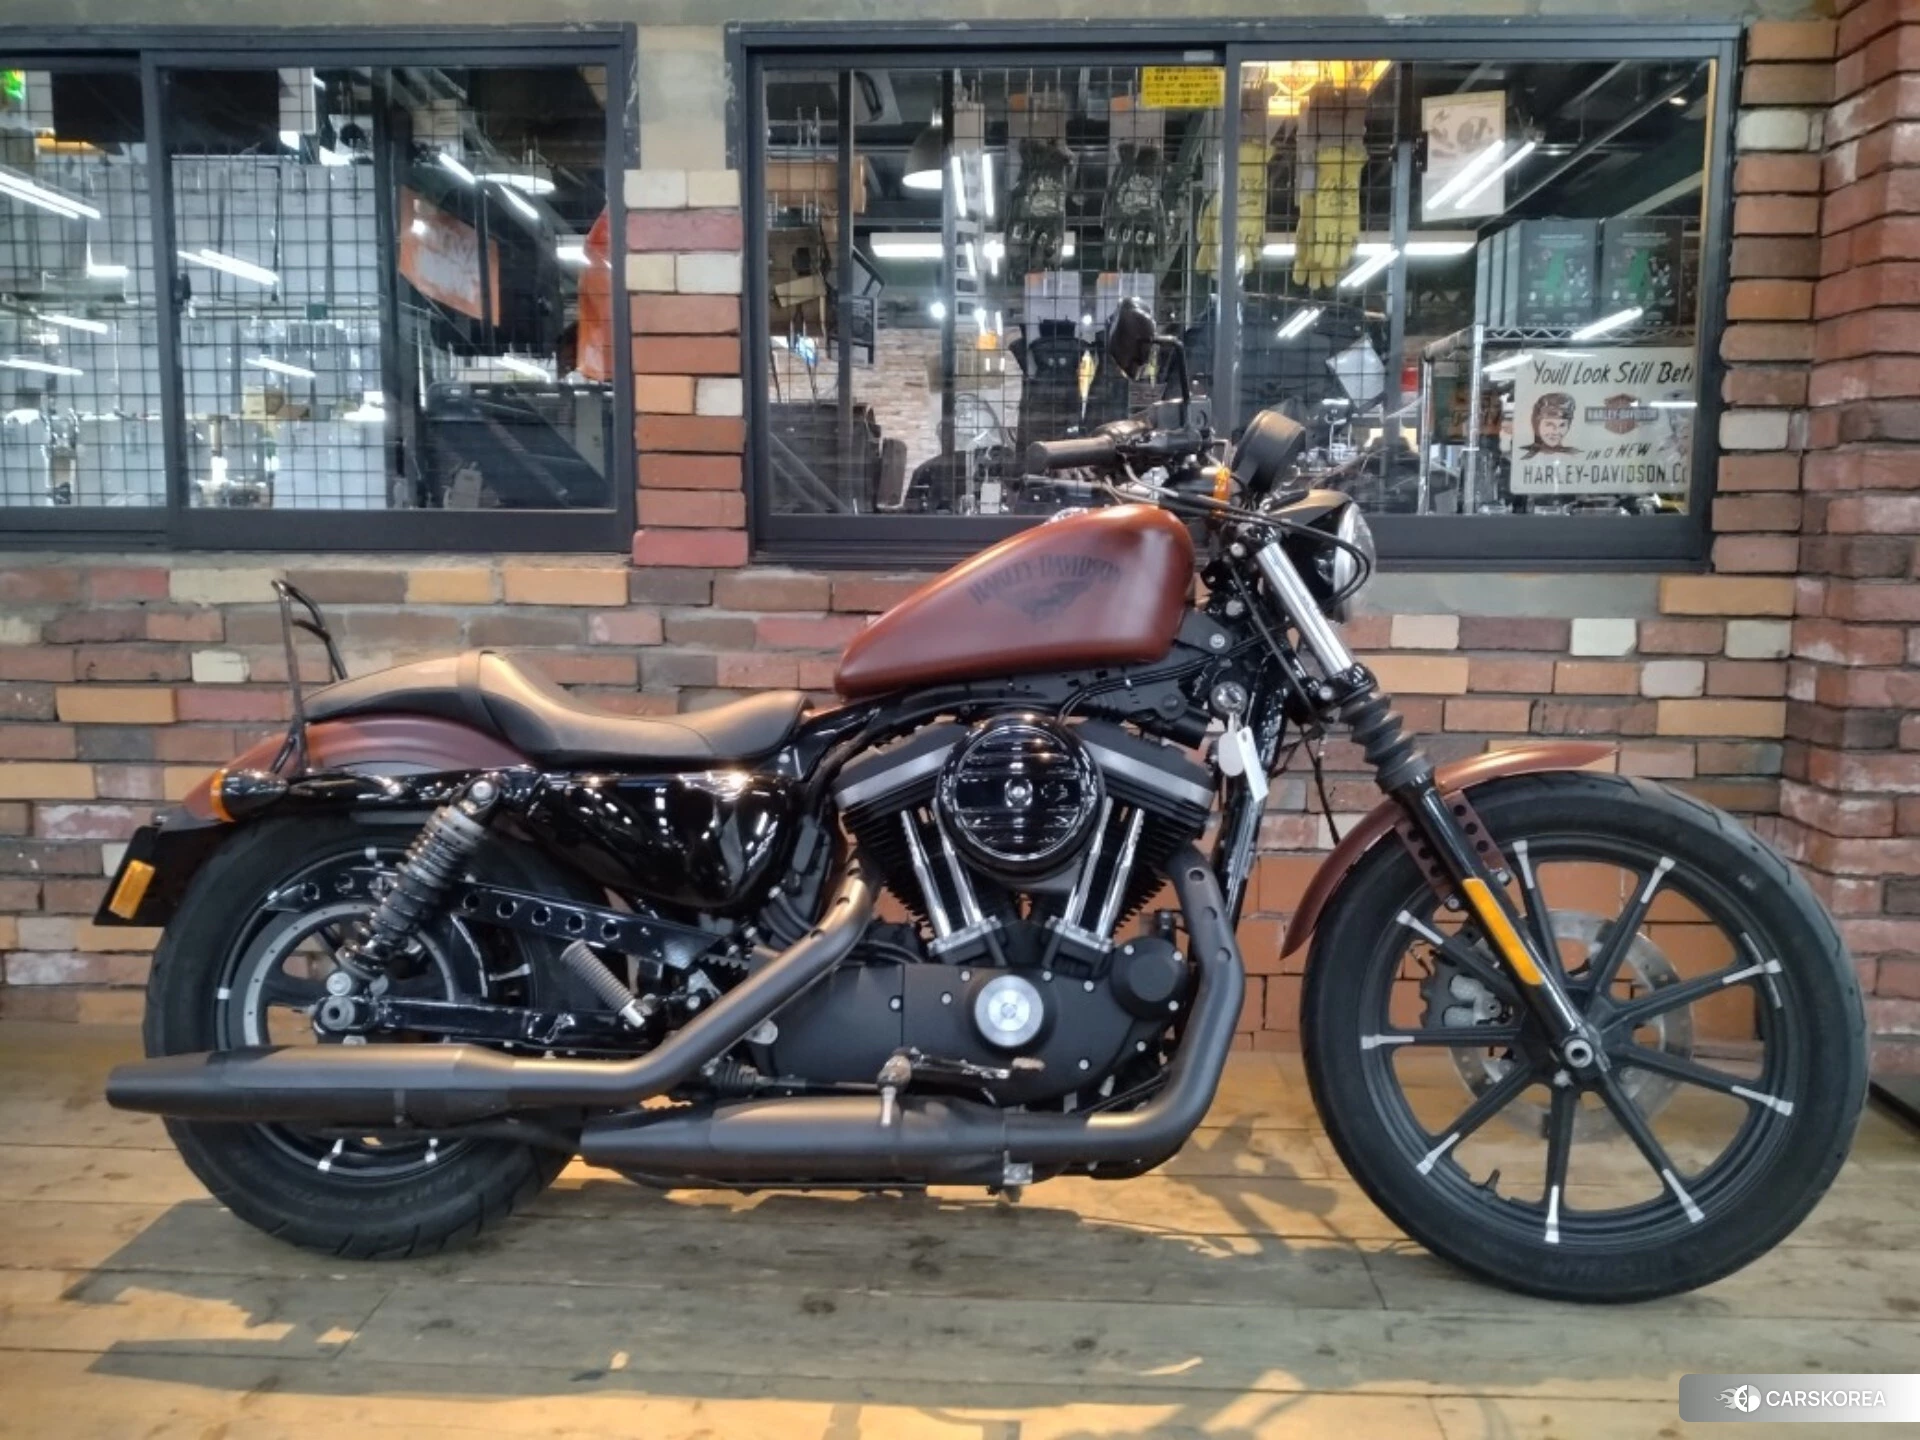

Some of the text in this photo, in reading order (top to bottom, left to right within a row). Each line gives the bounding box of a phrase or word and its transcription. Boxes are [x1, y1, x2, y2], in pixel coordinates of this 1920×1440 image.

[1573, 362, 1611, 385] Look
[1614, 361, 1655, 385] Still
[1615, 442, 1652, 458] NEW
[1523, 464, 1665, 484] HARLEY-DAVIDSON
